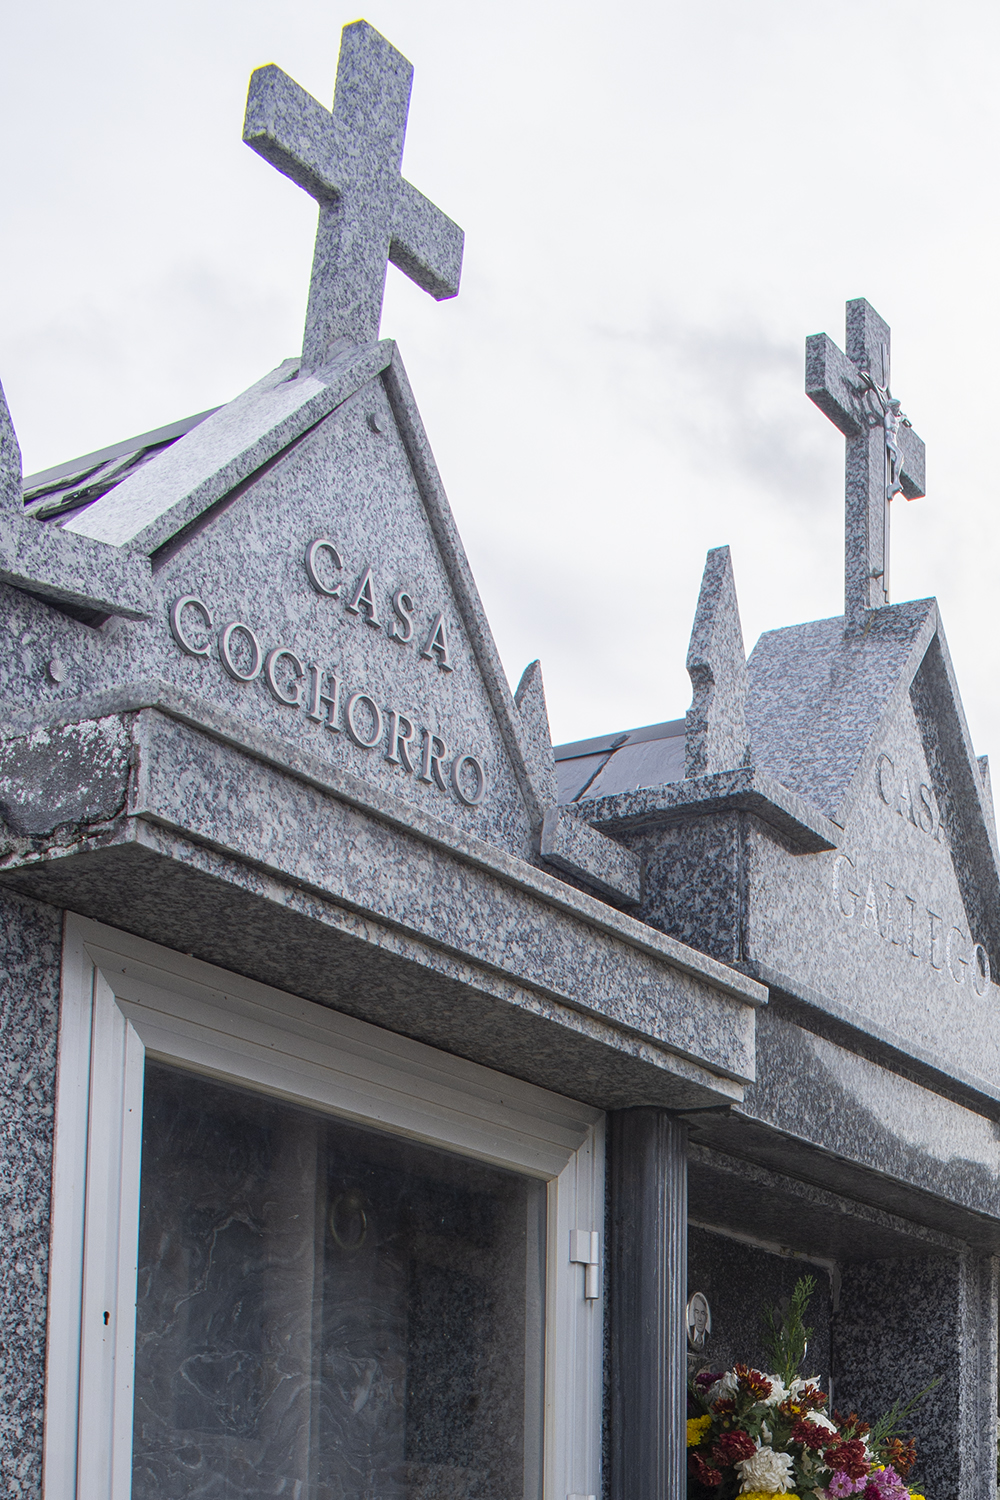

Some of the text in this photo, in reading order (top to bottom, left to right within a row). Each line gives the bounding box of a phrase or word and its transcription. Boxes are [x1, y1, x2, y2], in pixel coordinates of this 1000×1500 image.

[304, 538, 454, 672] CASA
[169, 594, 487, 806] COGHORRO
[875, 752, 949, 845] CASA
[832, 854, 991, 998] GALLEGO
